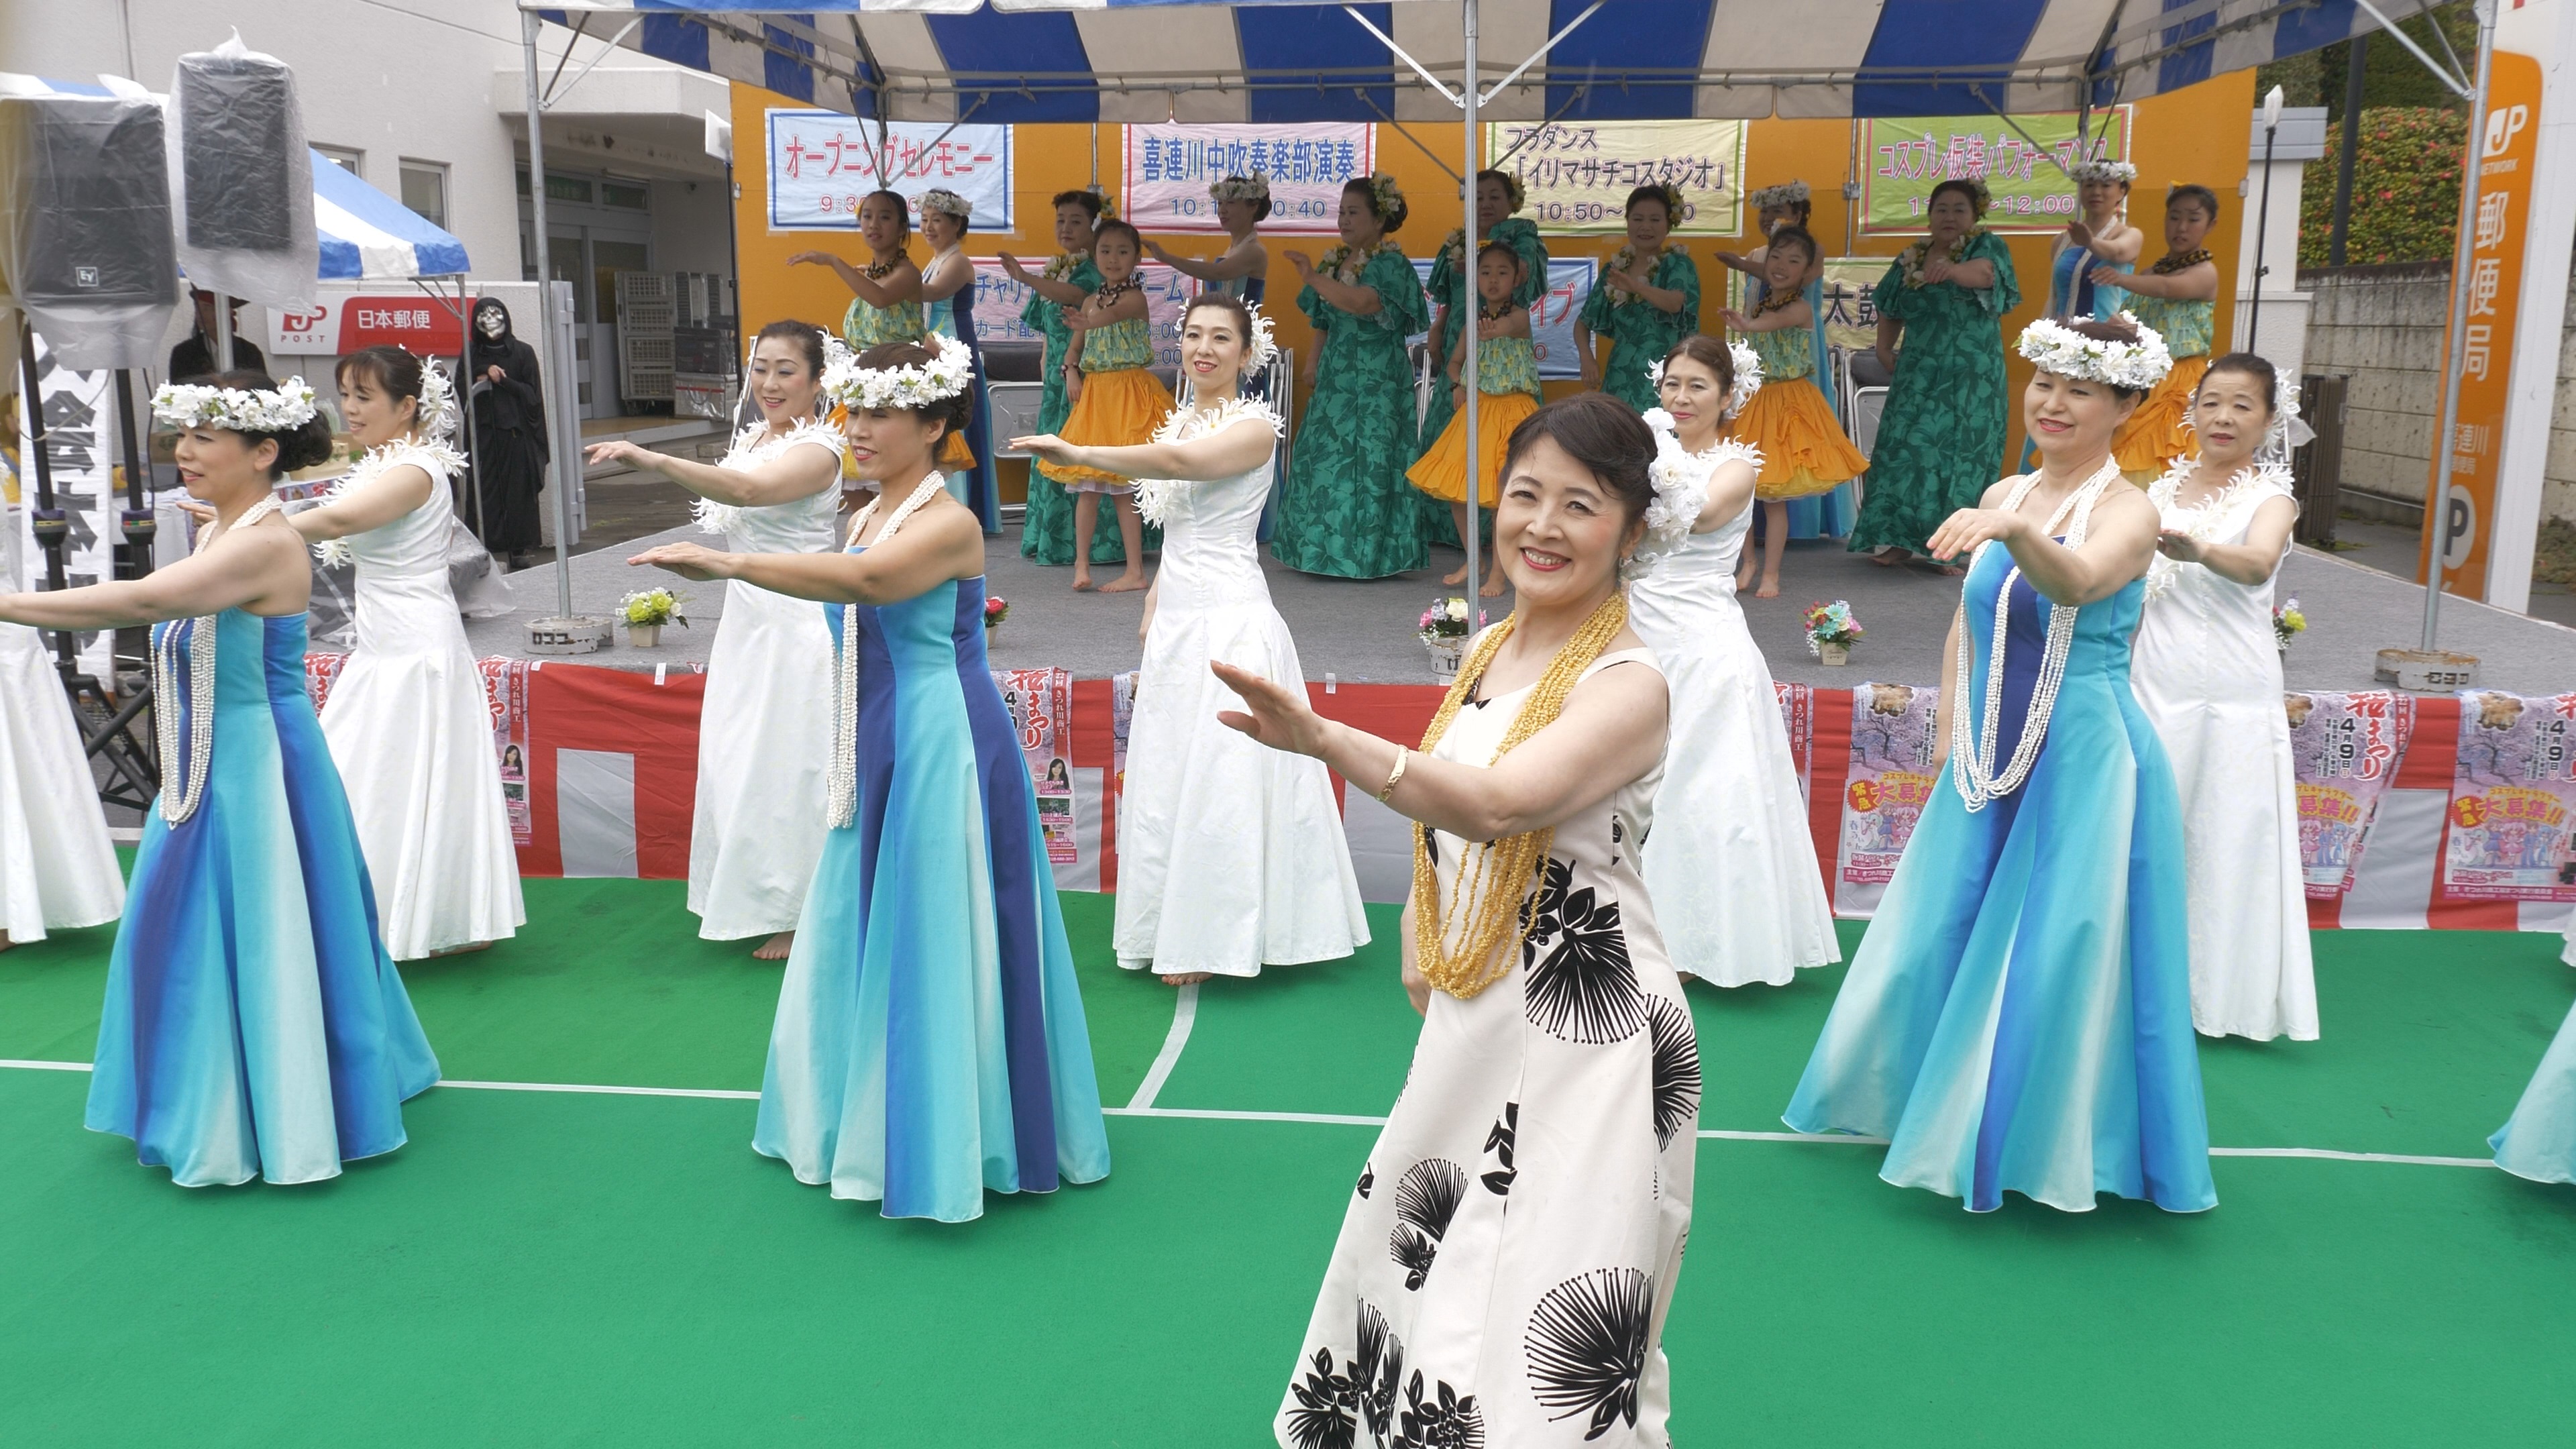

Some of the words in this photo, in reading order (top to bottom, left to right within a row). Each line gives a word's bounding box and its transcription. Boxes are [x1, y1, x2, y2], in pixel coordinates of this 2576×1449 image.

[785, 131, 994, 180] オープニングセレモニー
[1142, 136, 1356, 183] 喜連川中吹奏楽部演奏
[1505, 127, 1599, 152] フラダンス
[2461, 191, 2510, 381] 郵便局
[280, 335, 325, 343] POST
[358, 309, 431, 329] 日本郵便
[1055, 690, 1065, 735] きつれ川商工
[1794, 704, 1805, 751] きつれ川商工
